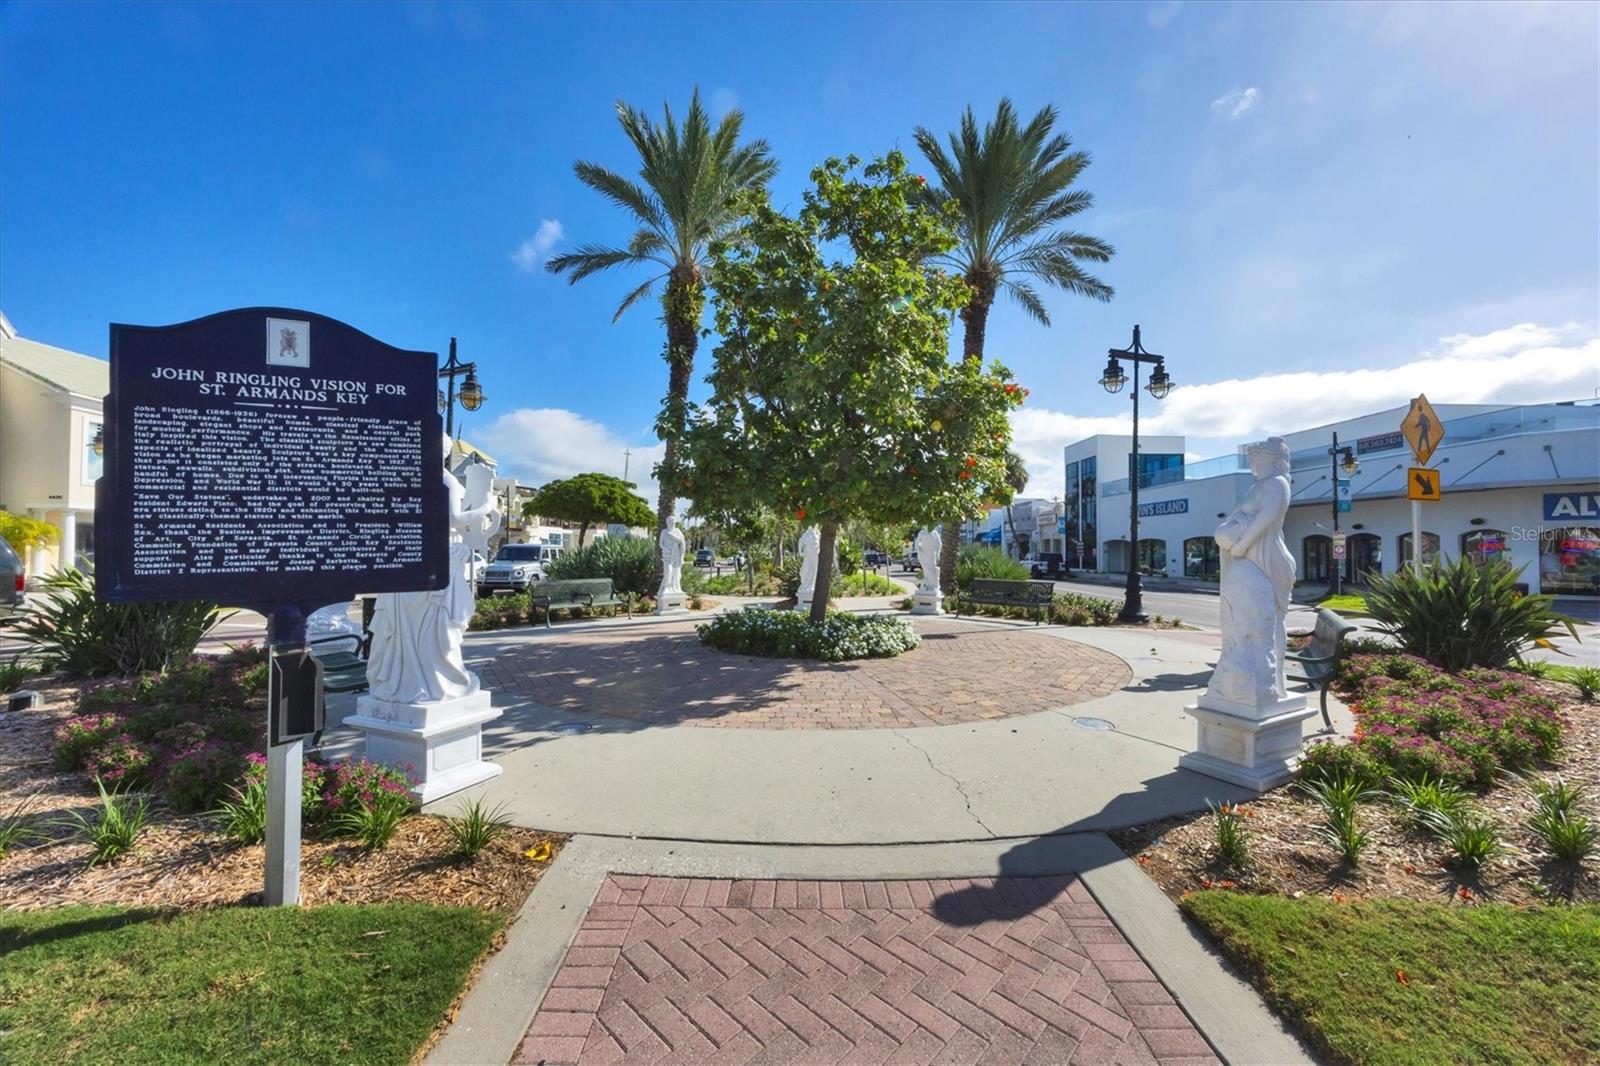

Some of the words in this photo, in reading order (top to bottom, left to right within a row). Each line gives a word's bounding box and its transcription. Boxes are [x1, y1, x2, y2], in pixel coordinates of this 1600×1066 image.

[152, 367, 204, 381] JOHN
[216, 372, 300, 388] RINGLING
[310, 378, 366, 393] VISION
[374, 383, 407, 396] FOR
[200, 383, 225, 396] ST.
[236, 386, 327, 402] ARMANDS
[336, 392, 369, 404] KEY
[162, 406, 198, 414] Ringling
[200, 421, 232, 429] elegant
[160, 432, 196, 440] inspired
[317, 438, 353, 446] sculpture
[201, 440, 242, 448] portrayal
[271, 449, 310, 457] Sculpture
[1155, 500, 1186, 514] ISLAND
